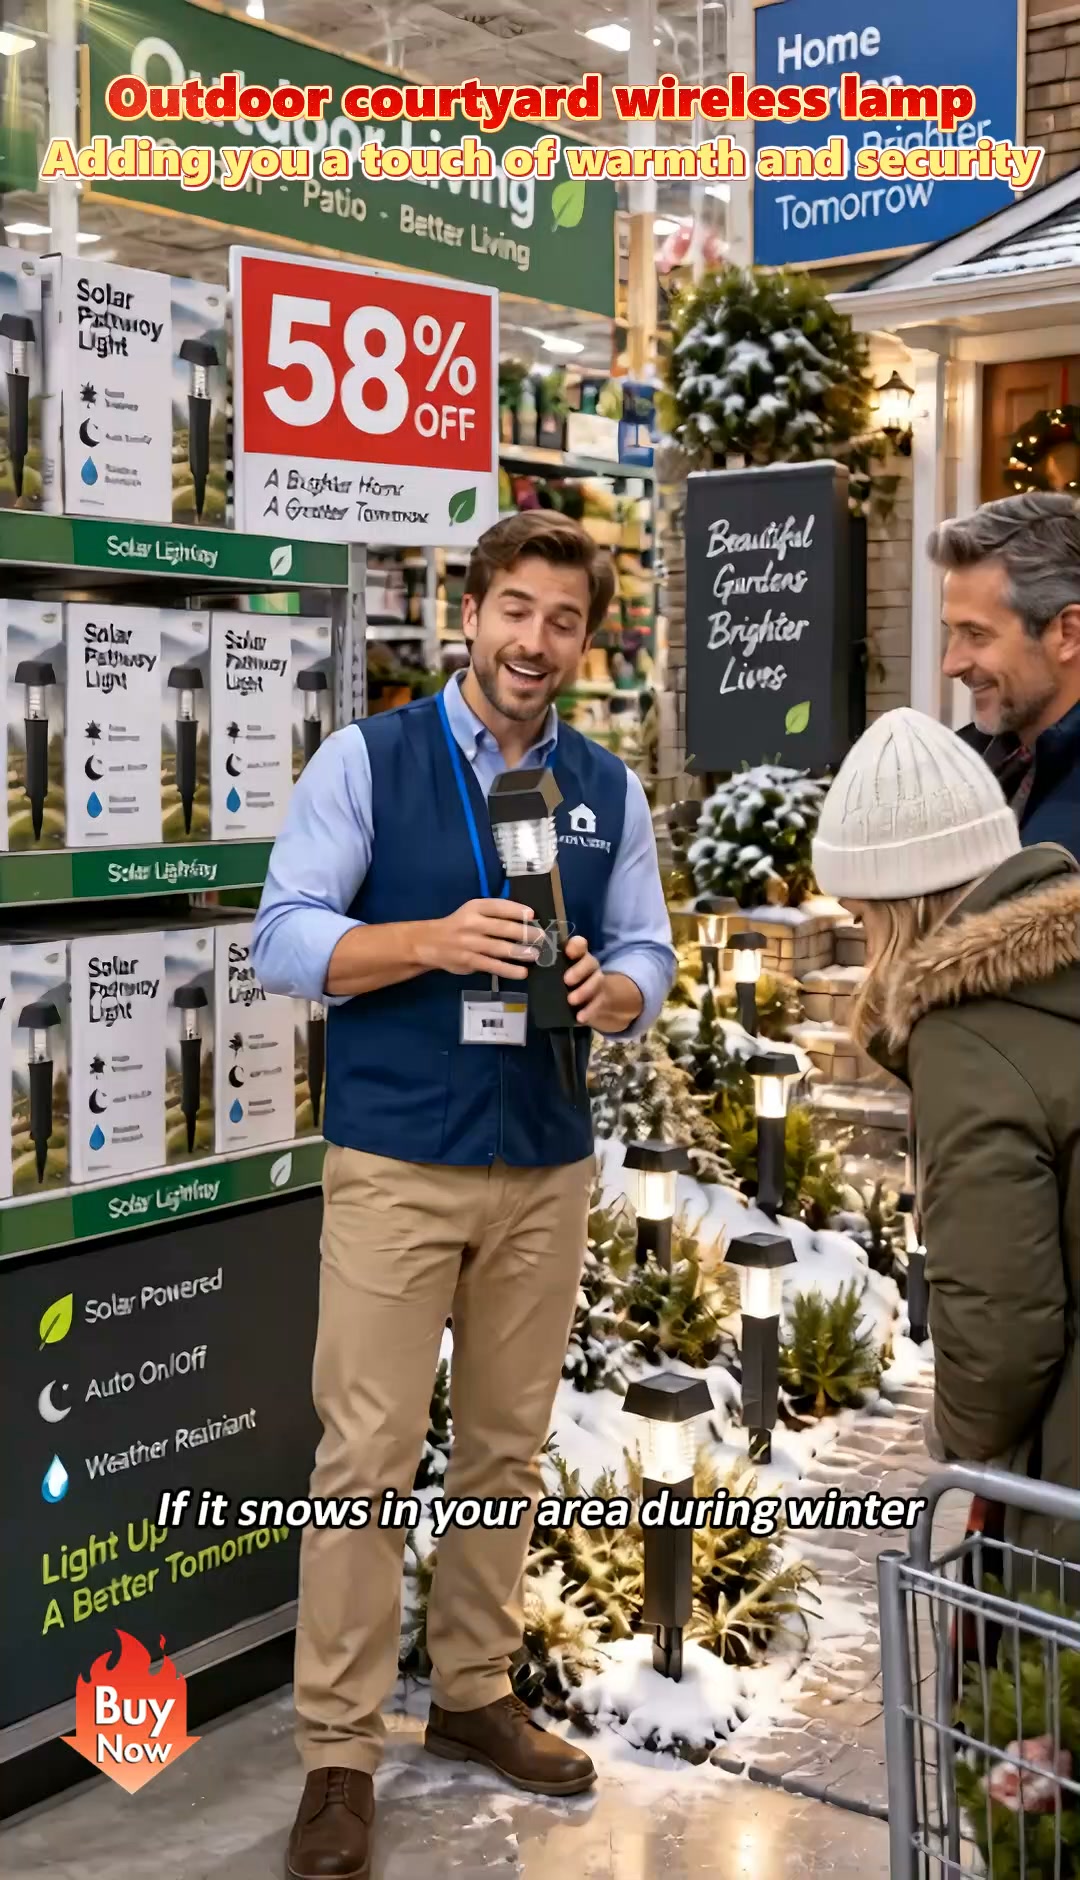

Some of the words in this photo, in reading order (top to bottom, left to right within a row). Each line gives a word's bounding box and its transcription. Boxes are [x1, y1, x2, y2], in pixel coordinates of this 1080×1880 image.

[777, 25, 881, 74] Home
[302, 179, 368, 222] Patio
[400, 204, 464, 247] Better
[470, 223, 531, 272] Living
[775, 180, 935, 231] Tomorrow
[76, 278, 135, 310] Solar
[414, 402, 477, 442] OFF
[263, 467, 279, 489] A
[263, 495, 279, 517] A
[707, 608, 810, 658] Brighter
[85, 1293, 136, 1324] Solar
[85, 1371, 135, 1402] Auto
[42, 1531, 119, 1585] Light
[42, 1598, 65, 1636] A
[73, 1567, 160, 1623] Better
